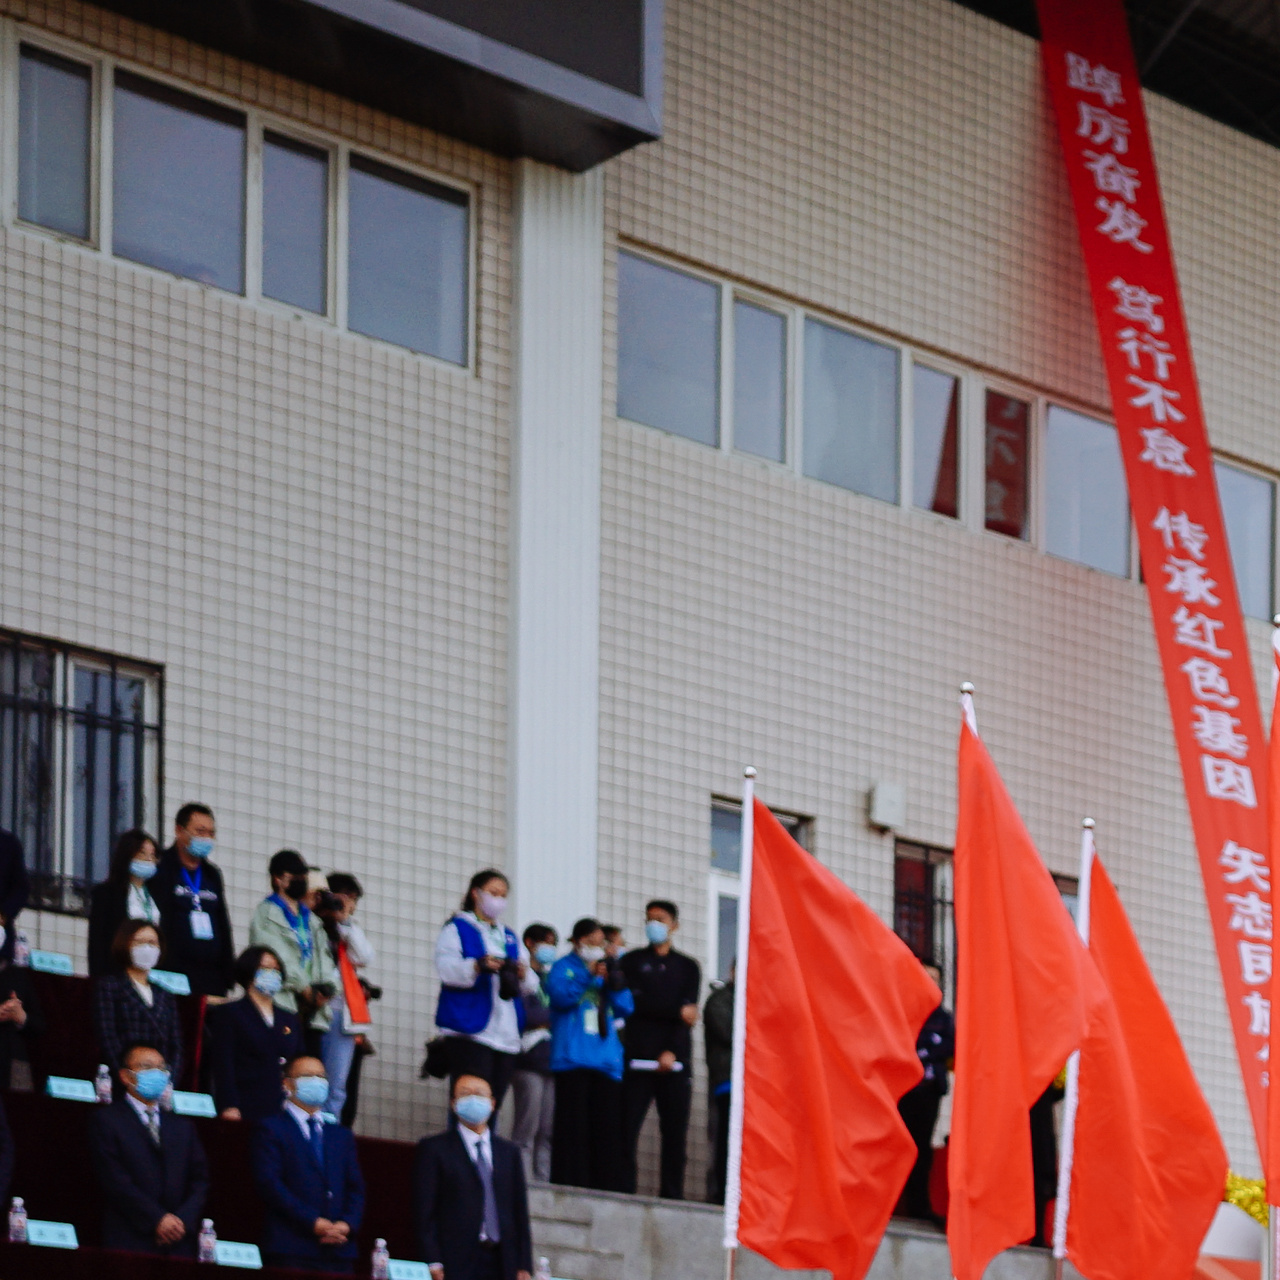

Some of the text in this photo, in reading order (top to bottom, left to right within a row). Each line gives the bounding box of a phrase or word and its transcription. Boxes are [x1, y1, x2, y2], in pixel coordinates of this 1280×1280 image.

[1065, 51, 1155, 254] 踔厉奋发
[1151, 505, 1258, 809] 传承红色基因
